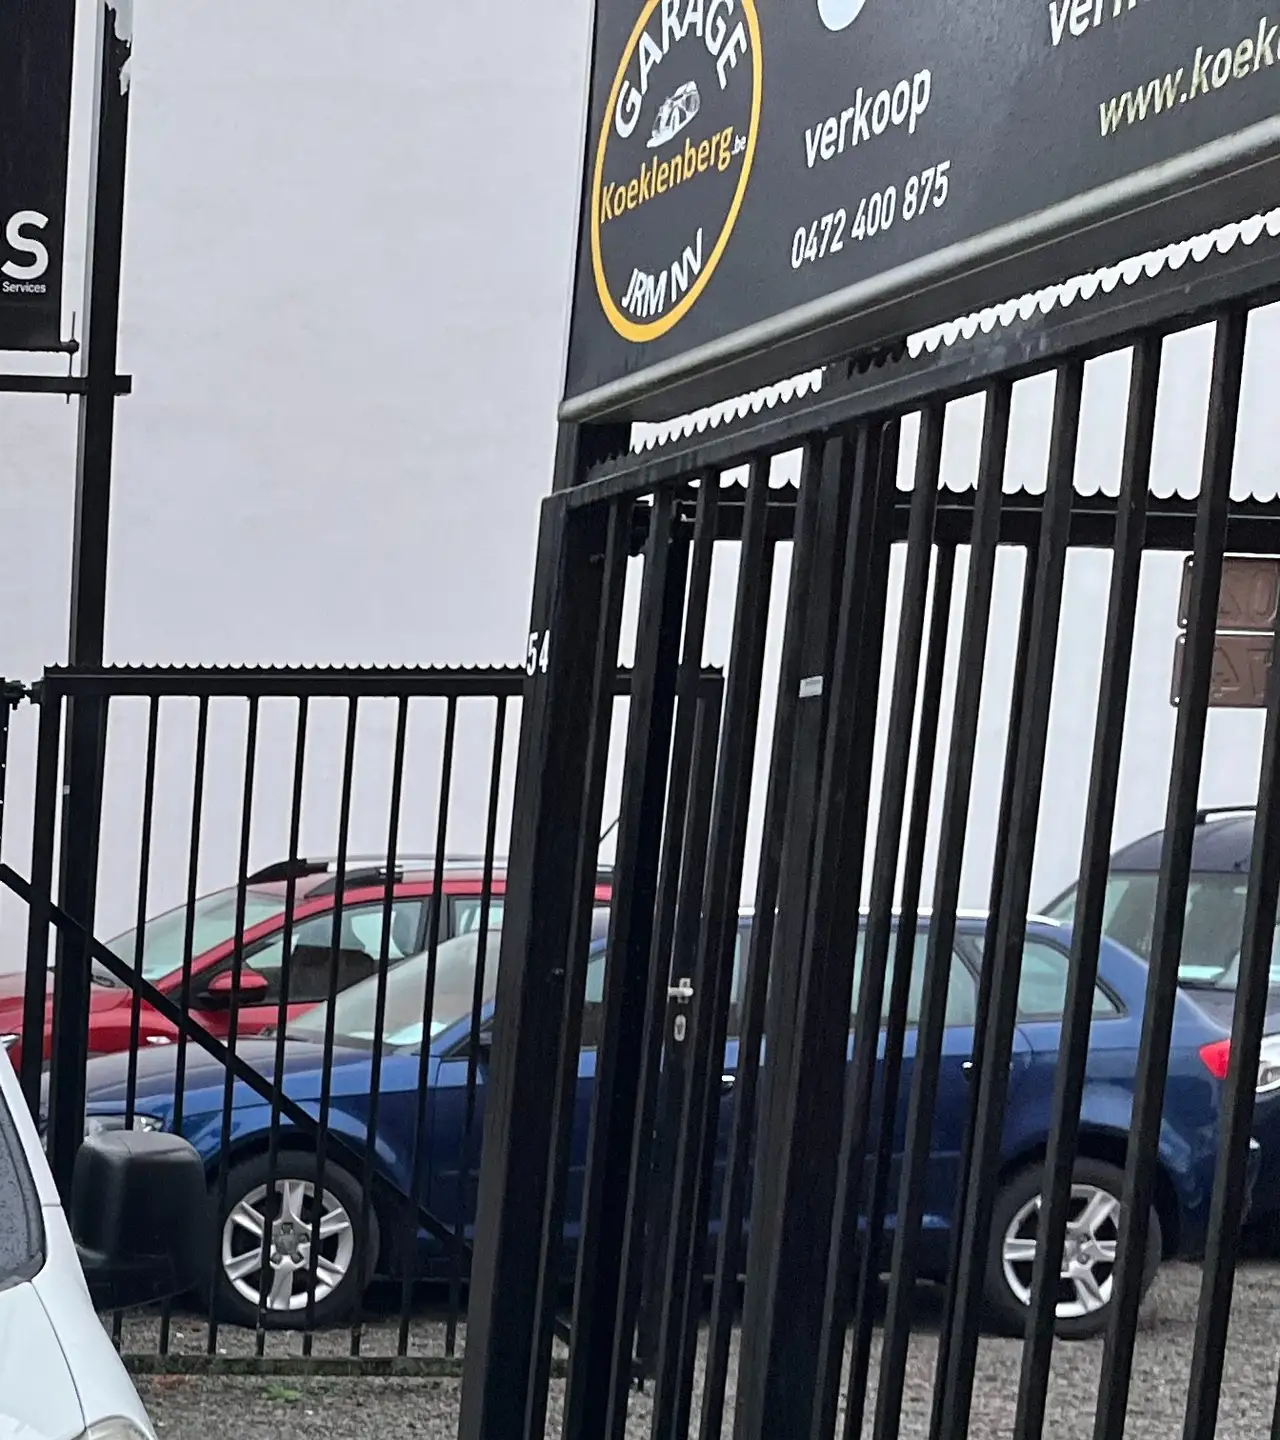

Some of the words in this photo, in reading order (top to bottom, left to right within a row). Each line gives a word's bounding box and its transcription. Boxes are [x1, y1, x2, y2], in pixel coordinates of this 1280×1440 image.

[1099, 16, 1280, 137] www.koek
[805, 69, 931, 168] verkoop
[791, 208, 847, 269] 0472
[851, 186, 897, 240] 400
[902, 160, 951, 221] 875
[2, 281, 47, 294] Services
[621, 268, 668, 318] JRM
[526, 629, 550, 677] 54
